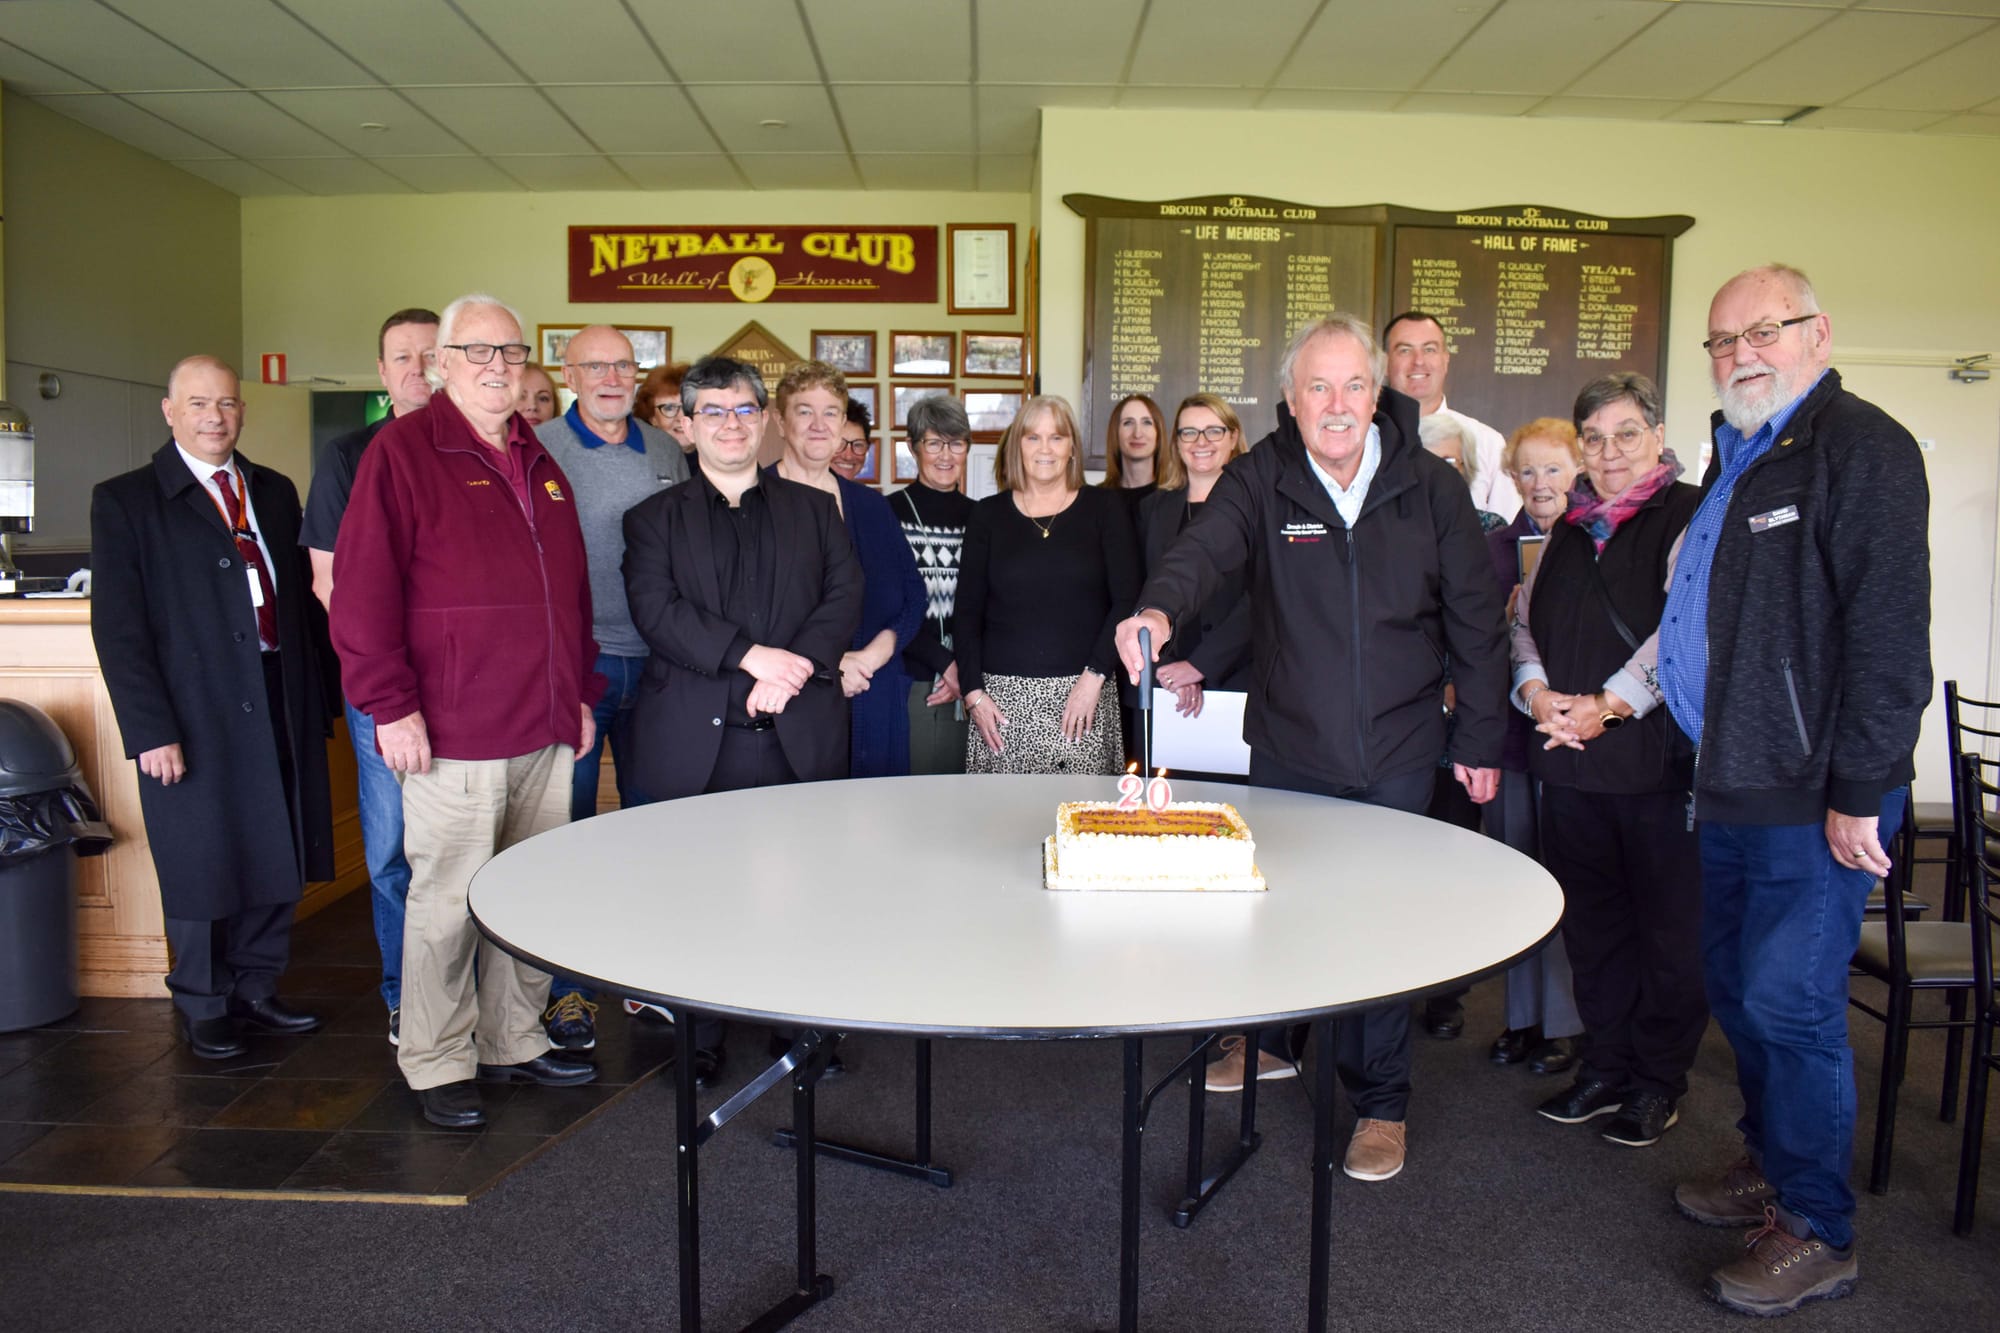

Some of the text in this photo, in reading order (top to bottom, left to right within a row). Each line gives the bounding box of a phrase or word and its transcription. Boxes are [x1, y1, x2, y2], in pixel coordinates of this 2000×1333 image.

[1161, 205, 1316, 220] DROUIN FOOTBALL CLUB
[1456, 215, 1608, 230] DROUIN FOOTBALL CLUB
[1196, 225, 1281, 242] LIFE MEMBERS
[1484, 235, 1578, 253] HALL OF FAME
[589, 232, 917, 277] NETBALL CLUB
[628, 271, 873, 290] Wall of Honour
[1117, 773, 1173, 812] 20
